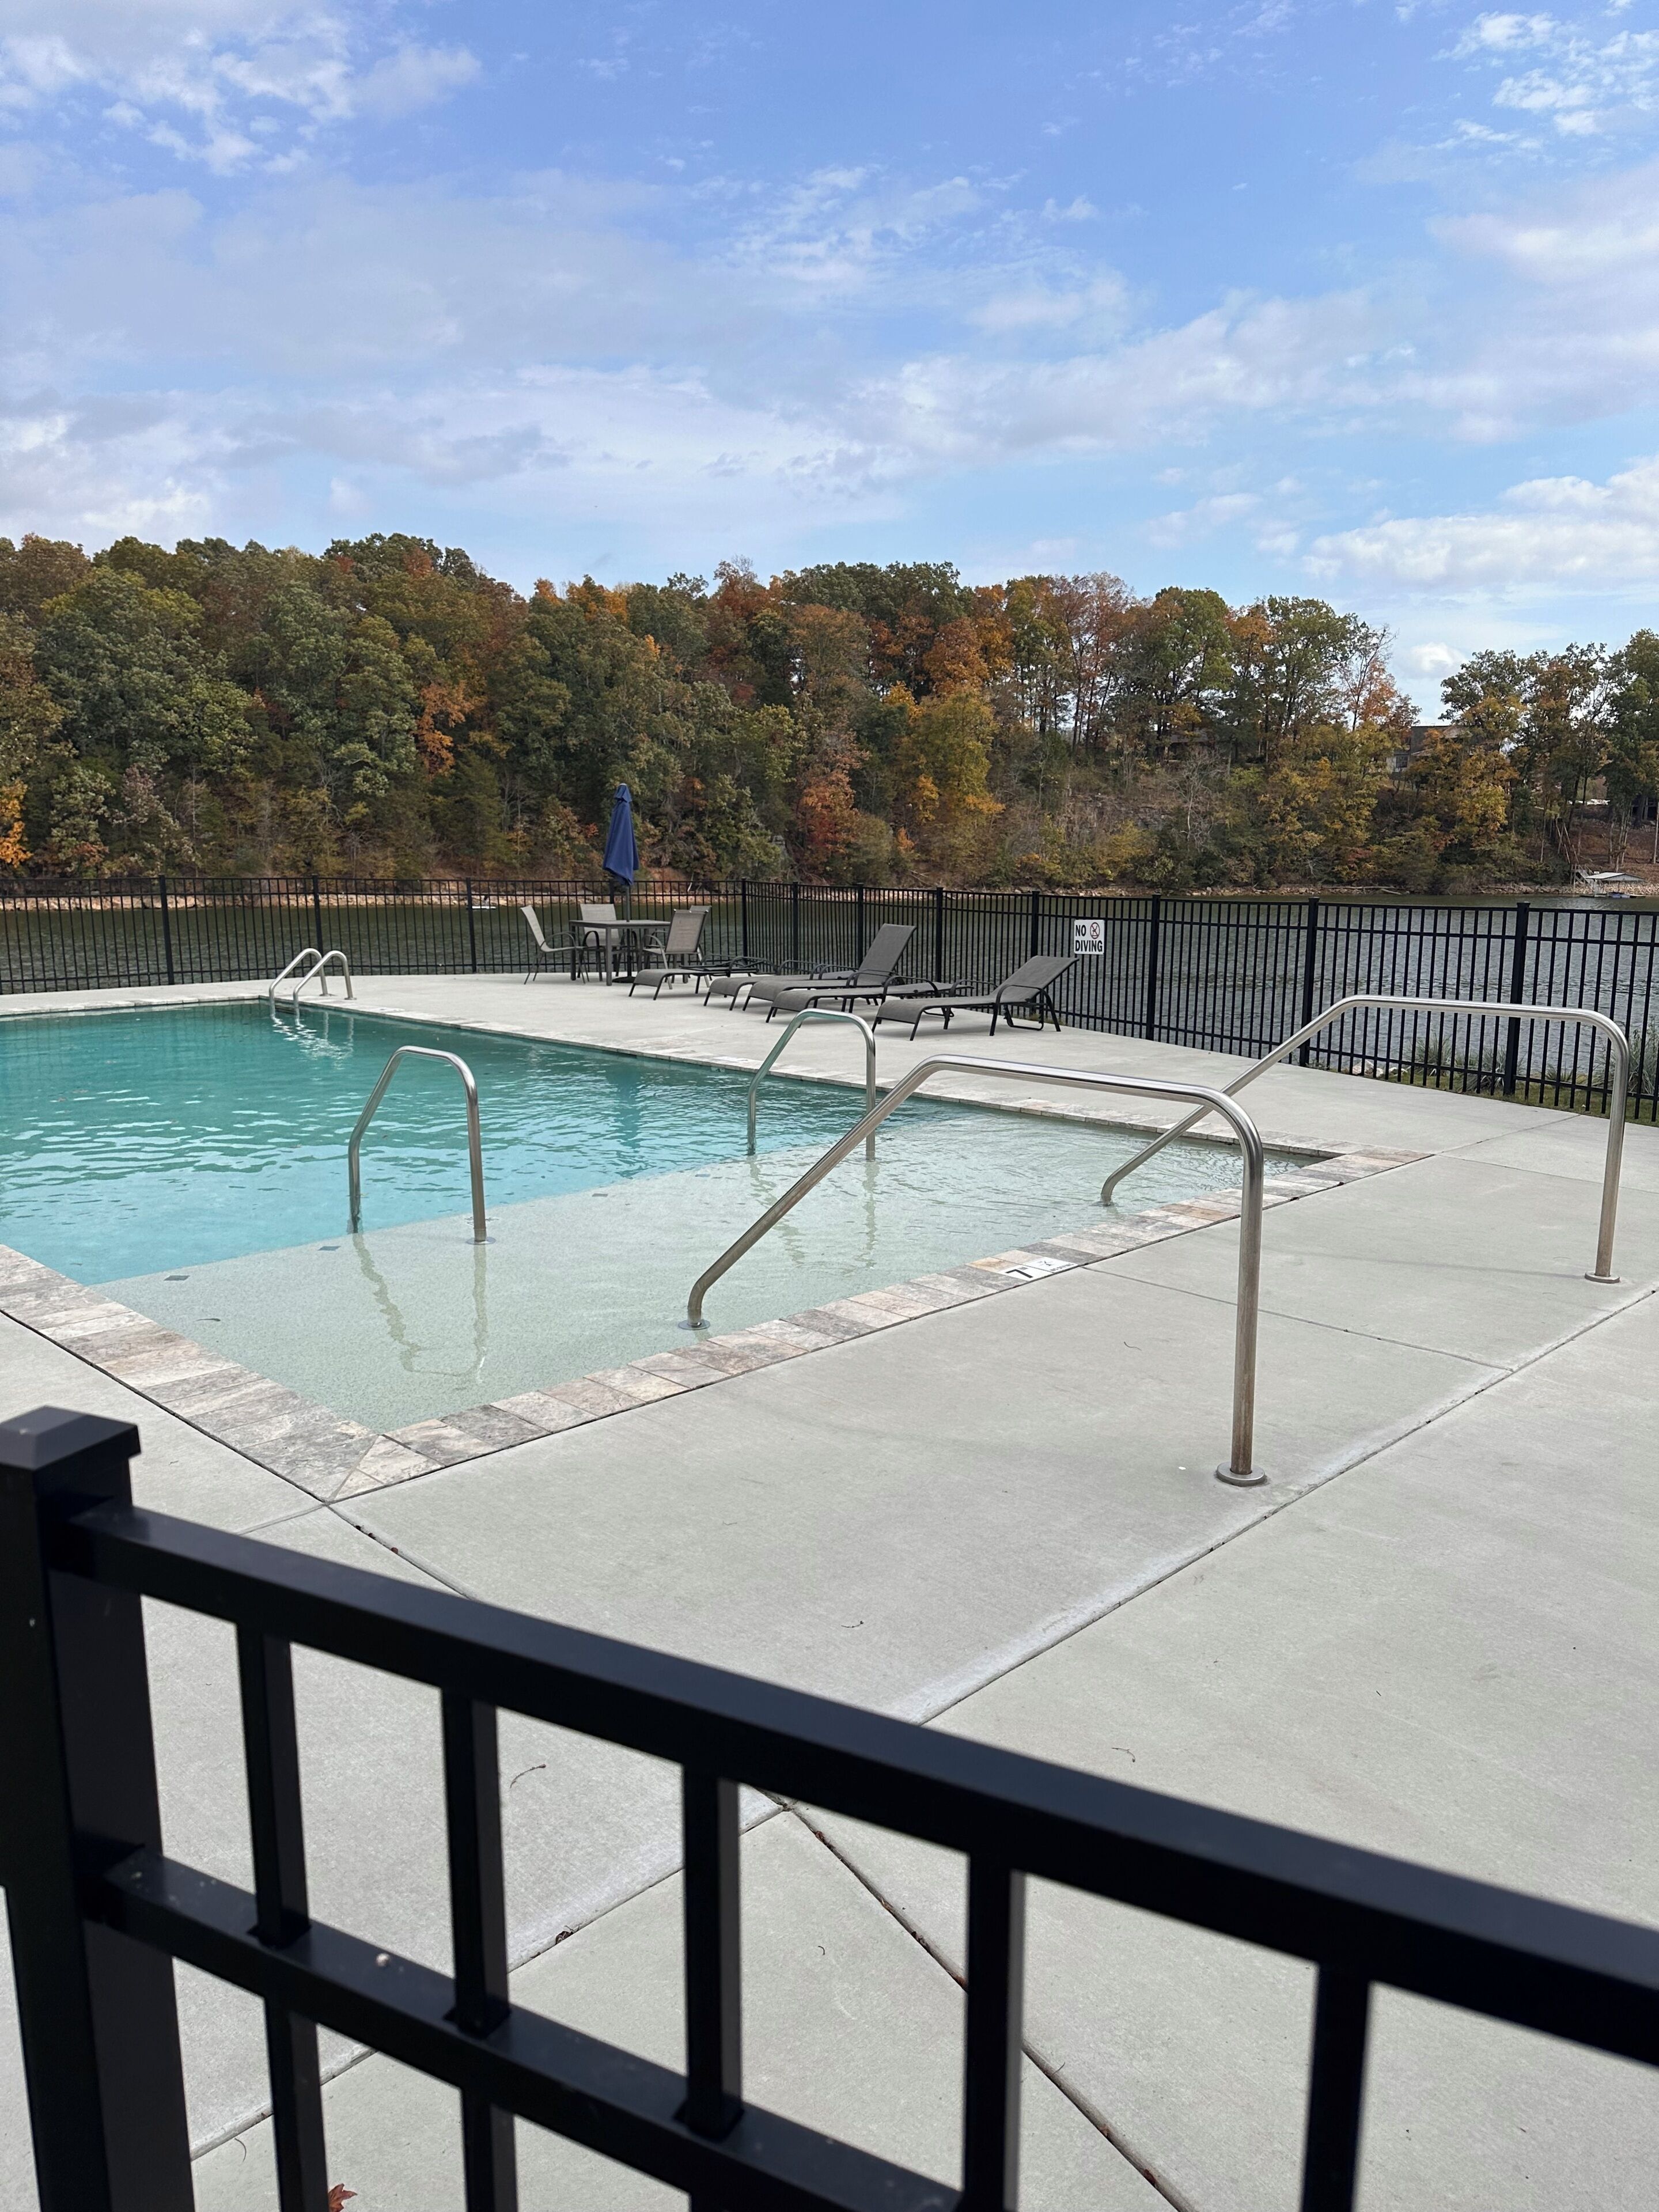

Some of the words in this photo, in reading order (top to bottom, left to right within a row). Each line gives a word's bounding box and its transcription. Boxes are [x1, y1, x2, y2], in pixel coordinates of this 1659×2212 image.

[1075, 925, 1086, 937] NO
[1075, 940, 1103, 952] DIVING
[1005, 1268, 1034, 1278] 7
